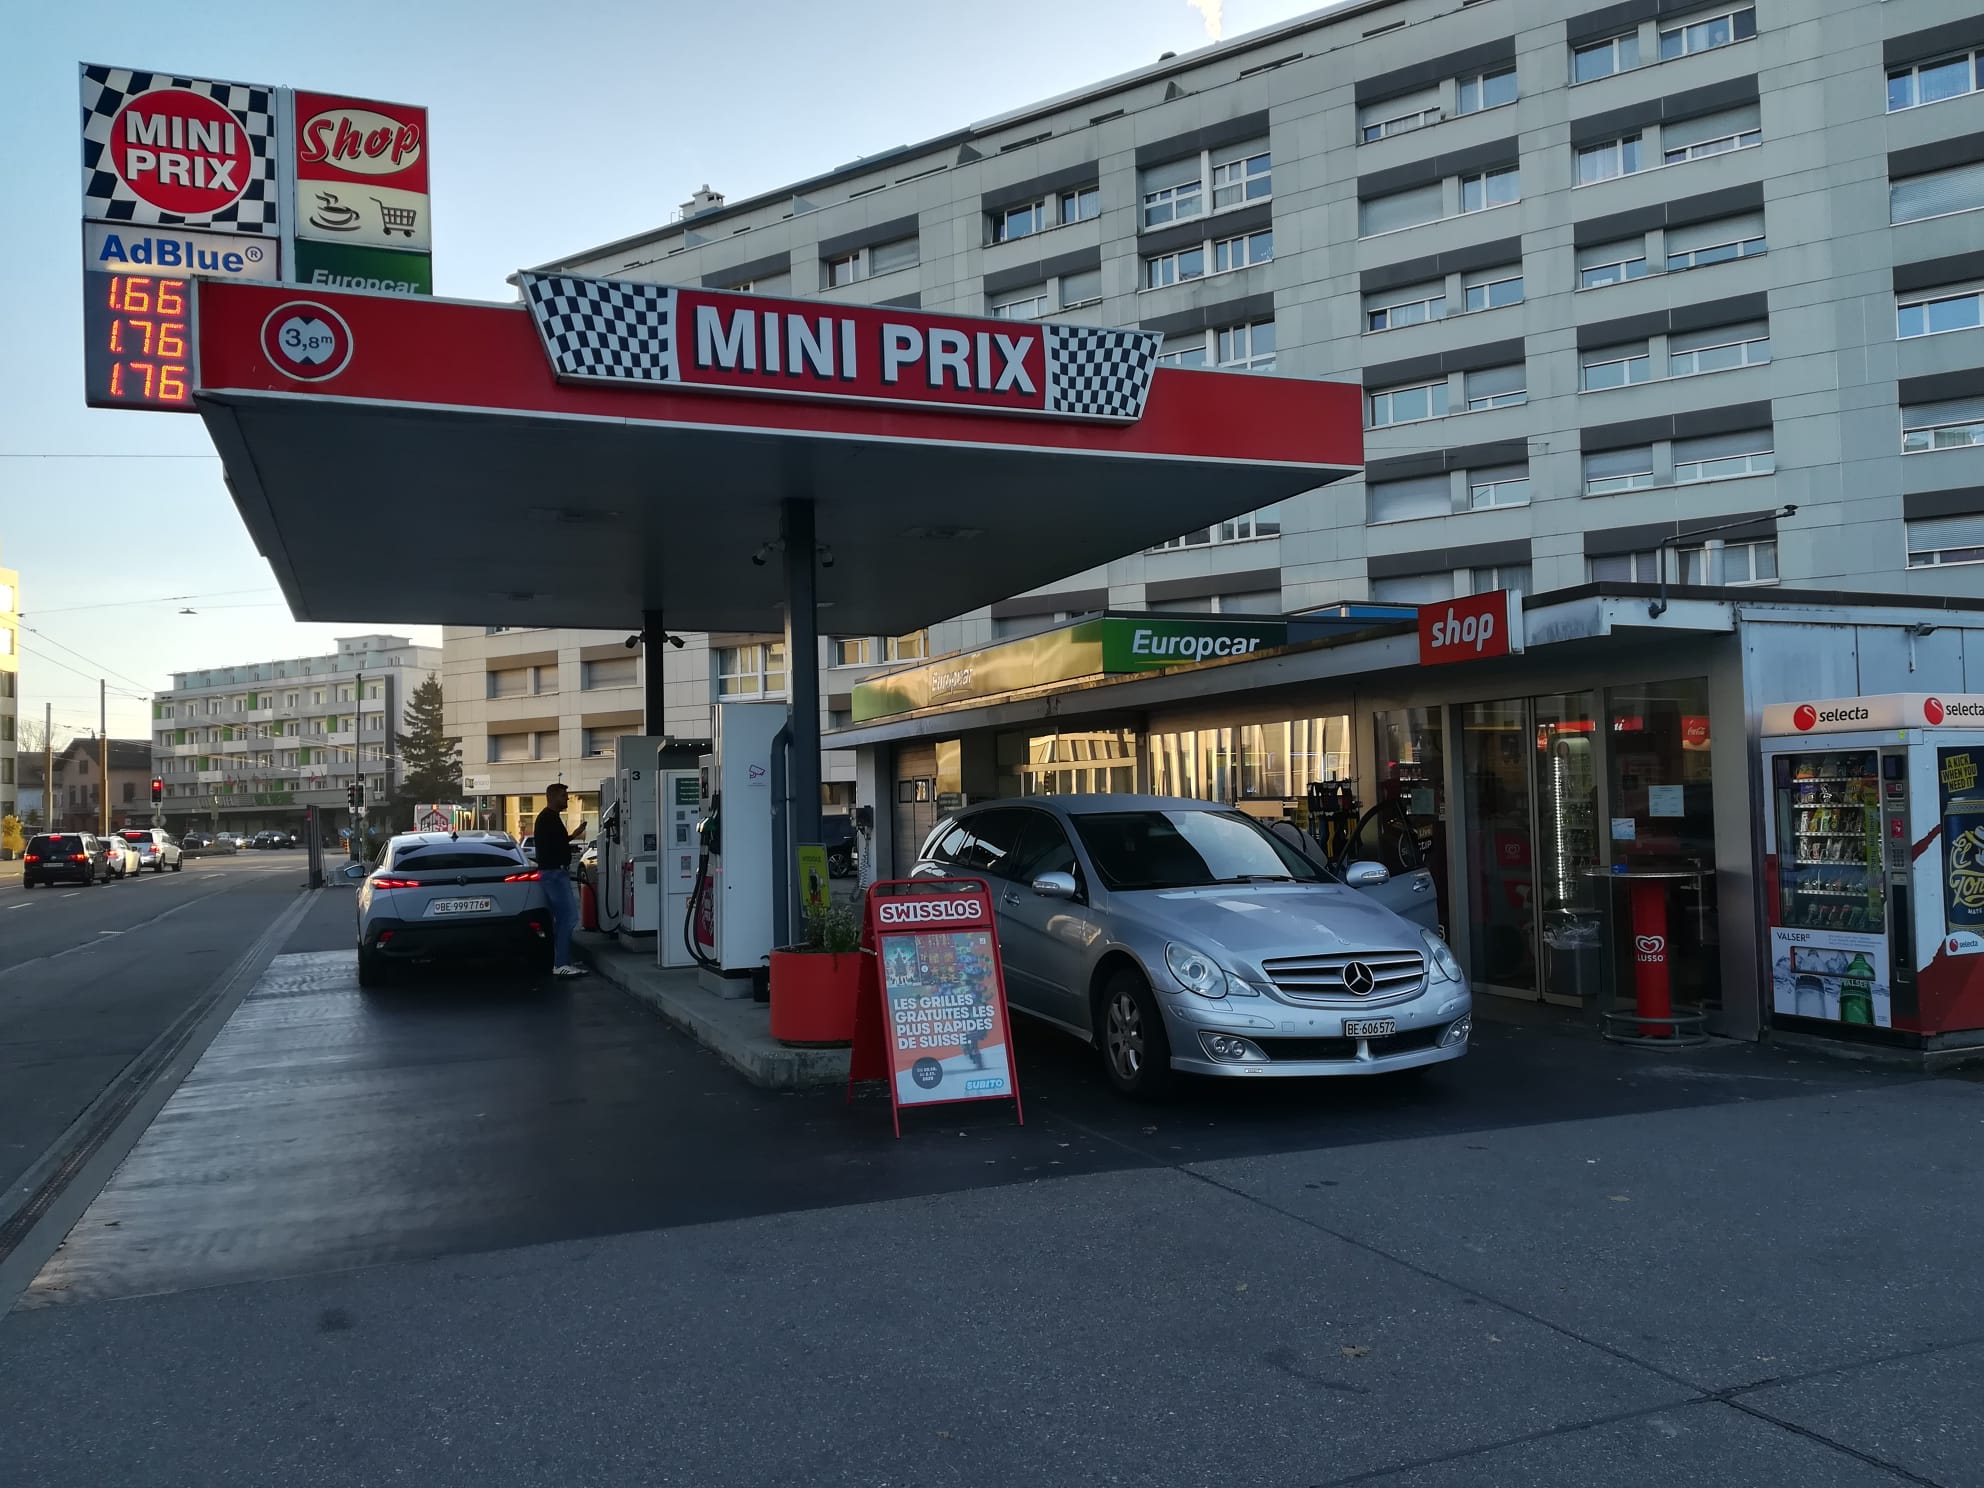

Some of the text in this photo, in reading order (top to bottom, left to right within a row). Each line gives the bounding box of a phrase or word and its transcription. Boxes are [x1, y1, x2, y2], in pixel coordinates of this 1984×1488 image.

[125, 110, 235, 156] MINI
[300, 117, 421, 165] Shop
[125, 148, 239, 192] PRIX
[311, 268, 420, 295] Europcar
[108, 276, 184, 315] 1.66
[108, 319, 185, 358] 1.76
[696, 304, 1038, 395] MINI PRIX
[108, 361, 185, 401] 1.76
[1431, 607, 1495, 652] shop
[1131, 628, 1260, 662] Europcar
[1818, 706, 1869, 723] selecta
[1945, 702, 1984, 717] selecta
[631, 770, 641, 781] 3
[1942, 764, 1977, 781] WHEN YOU
[1949, 776, 1974, 791] NEED IT
[453, 901, 485, 911] 999776
[881, 901, 980, 922] SWISSLOS
[1776, 932, 1807, 942] VALSER
[1959, 939, 1979, 949] selecta
[1637, 954, 1664, 962] LUSSO
[893, 994, 974, 1010] LES GRILLES
[895, 1005, 995, 1024] GRATUITES LES
[896, 1018, 993, 1037] PLUS RAPIDES
[898, 1033, 972, 1050] DE SUISSE.
[966, 1078, 1003, 1090] SUBITO
